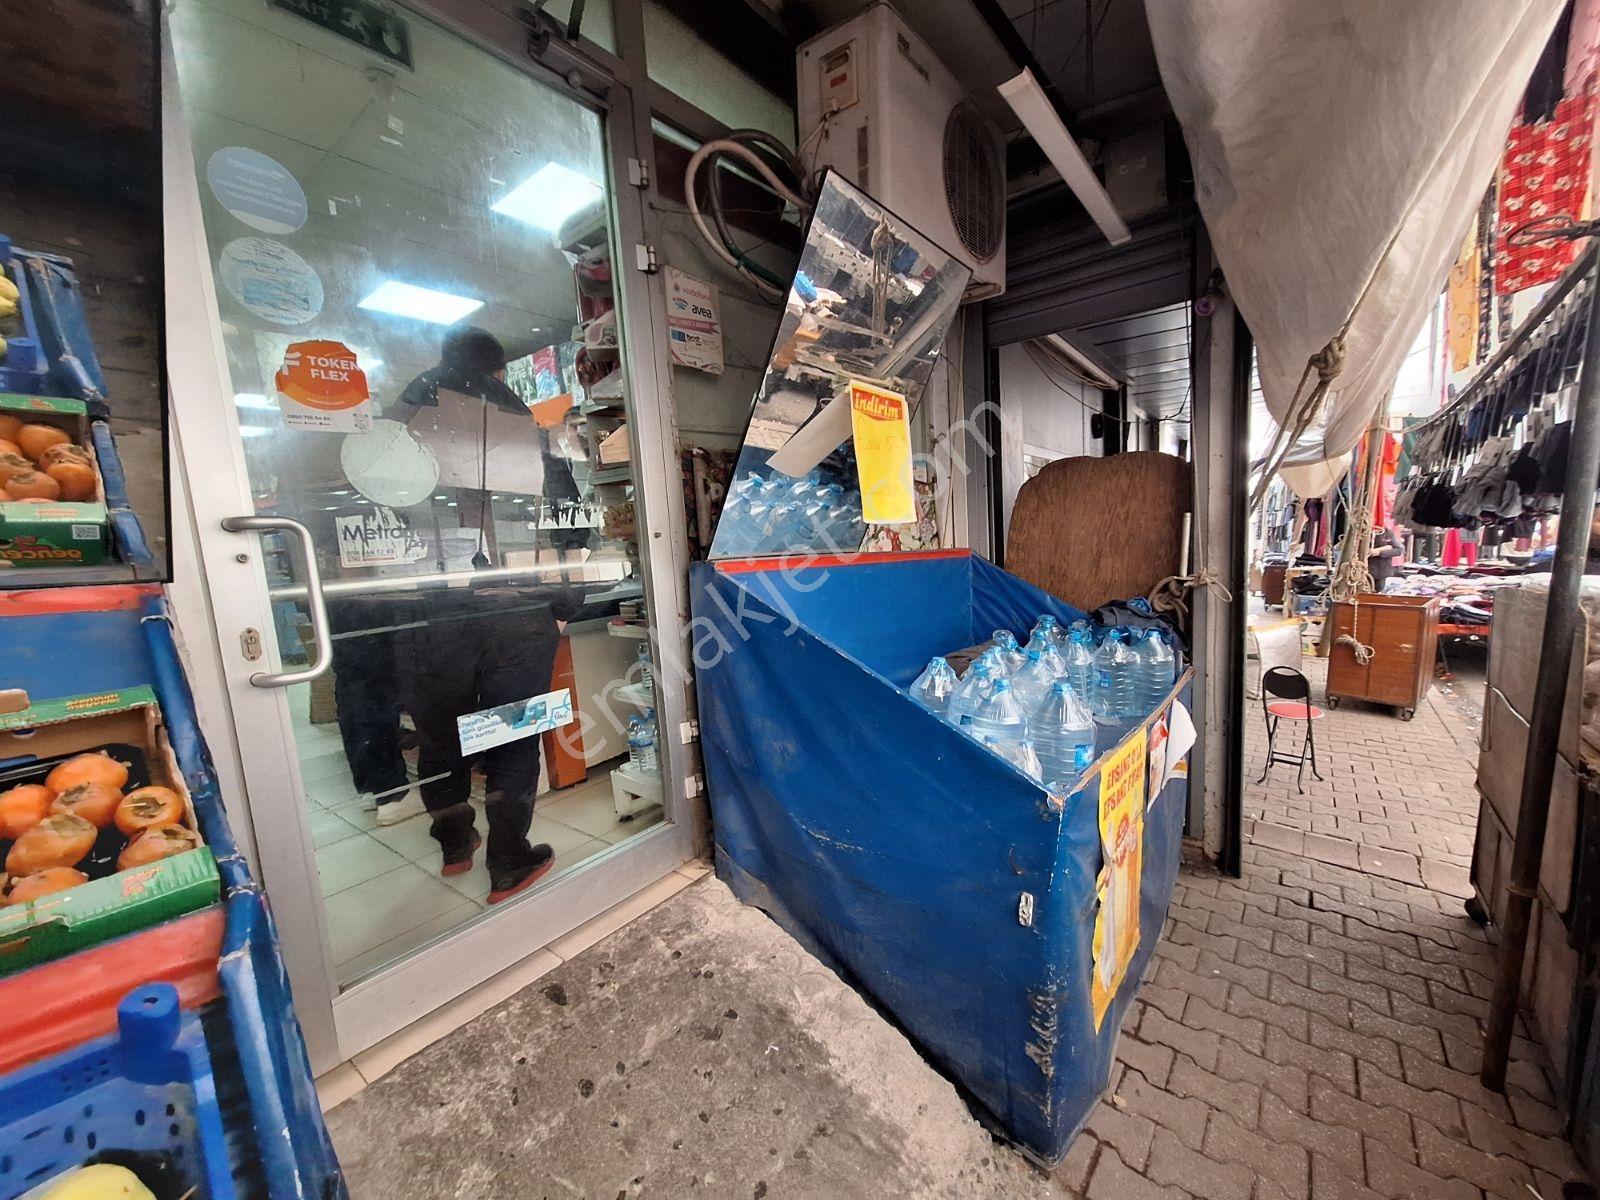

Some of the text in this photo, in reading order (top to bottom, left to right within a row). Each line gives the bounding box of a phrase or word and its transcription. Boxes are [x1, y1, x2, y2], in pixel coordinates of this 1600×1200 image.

[691, 304, 712, 319] avea
[306, 355, 360, 371] TOKEN
[310, 368, 350, 382] FLEX
